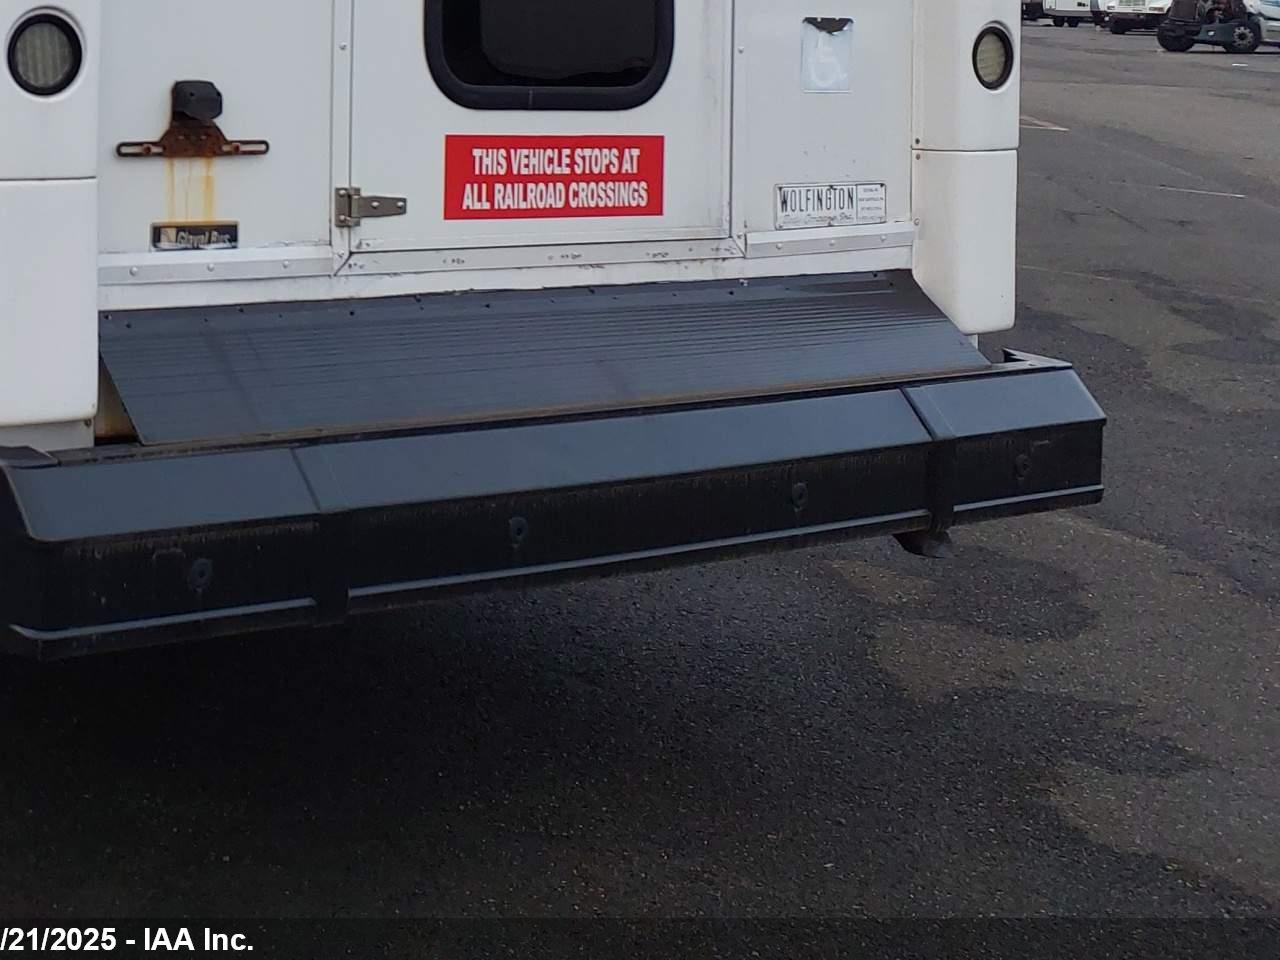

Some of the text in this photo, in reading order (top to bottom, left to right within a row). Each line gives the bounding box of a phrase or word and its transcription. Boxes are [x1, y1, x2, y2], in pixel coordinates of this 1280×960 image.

[472, 147, 640, 176] THIS VEHICLE STOPS AT
[462, 181, 648, 210] ALL RAILROAD CROSSINGS
[780, 186, 854, 213] WOLFINGTON
